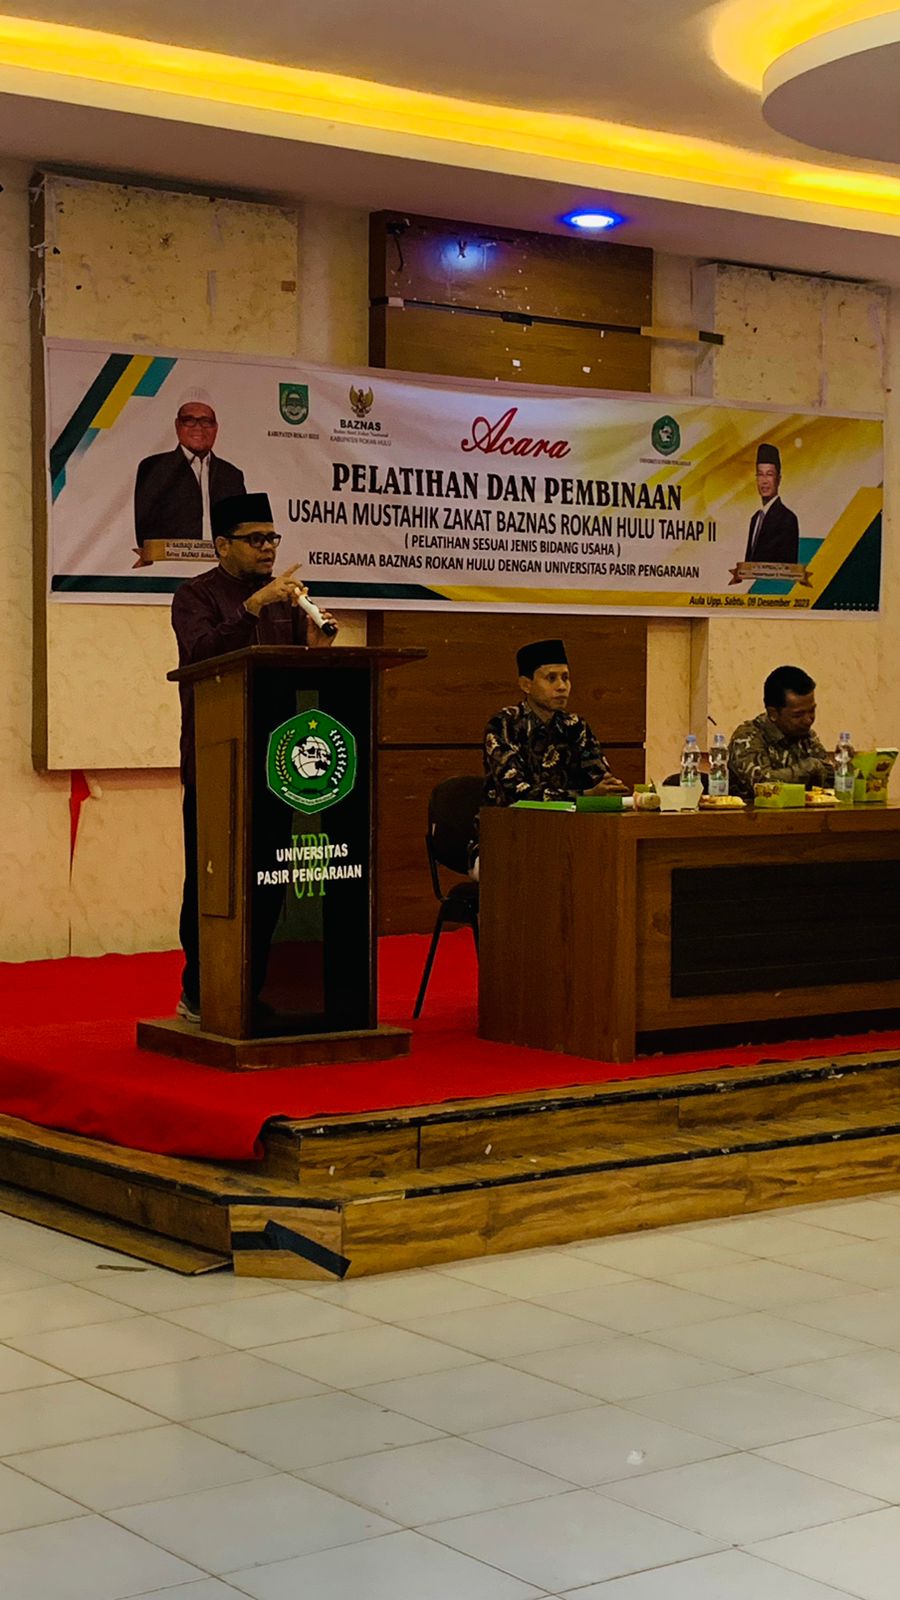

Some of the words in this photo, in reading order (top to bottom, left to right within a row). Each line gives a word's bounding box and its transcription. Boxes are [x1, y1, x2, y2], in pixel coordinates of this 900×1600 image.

[340, 419, 381, 431] BAZNAS
[461, 407, 572, 459] Acara
[332, 462, 478, 500] PELATIHAN
[487, 473, 536, 503] DAN
[544, 478, 682, 511] PEMBINAAN
[288, 499, 348, 525] USAHA
[353, 502, 439, 529] MUSTAHIK
[443, 507, 492, 532] ZAKAT
[497, 510, 556, 534] BAZNAS
[560, 514, 612, 538] ROKAN
[617, 517, 654, 540] HULU
[658, 519, 704, 542] TAHAP
[708, 522, 716, 542] II
[412, 535, 470, 550] PELATIHAN
[472, 537, 508, 552] SESUAI
[510, 539, 538, 553] JENIS
[540, 540, 578, 555] BIDANG
[581, 542, 614, 556] USAHA
[309, 552, 376, 568] KERJASAMA
[379, 554, 422, 570] BAZNAS
[425, 556, 464, 570] ROKAN
[466, 557, 495, 572] HULU
[498, 558, 542, 574] DENGAN
[544, 560, 607, 576] UNIVERSITAS
[610, 563, 636, 577] PASIR
[638, 564, 700, 578] PENGARAIAN
[689, 596, 704, 605] Aula
[758, 598, 790, 607] Desember
[276, 844, 348, 862] UNIVERSITAS
[257, 870, 290, 886] PASIR
[292, 864, 362, 883] PENGARAIAN
